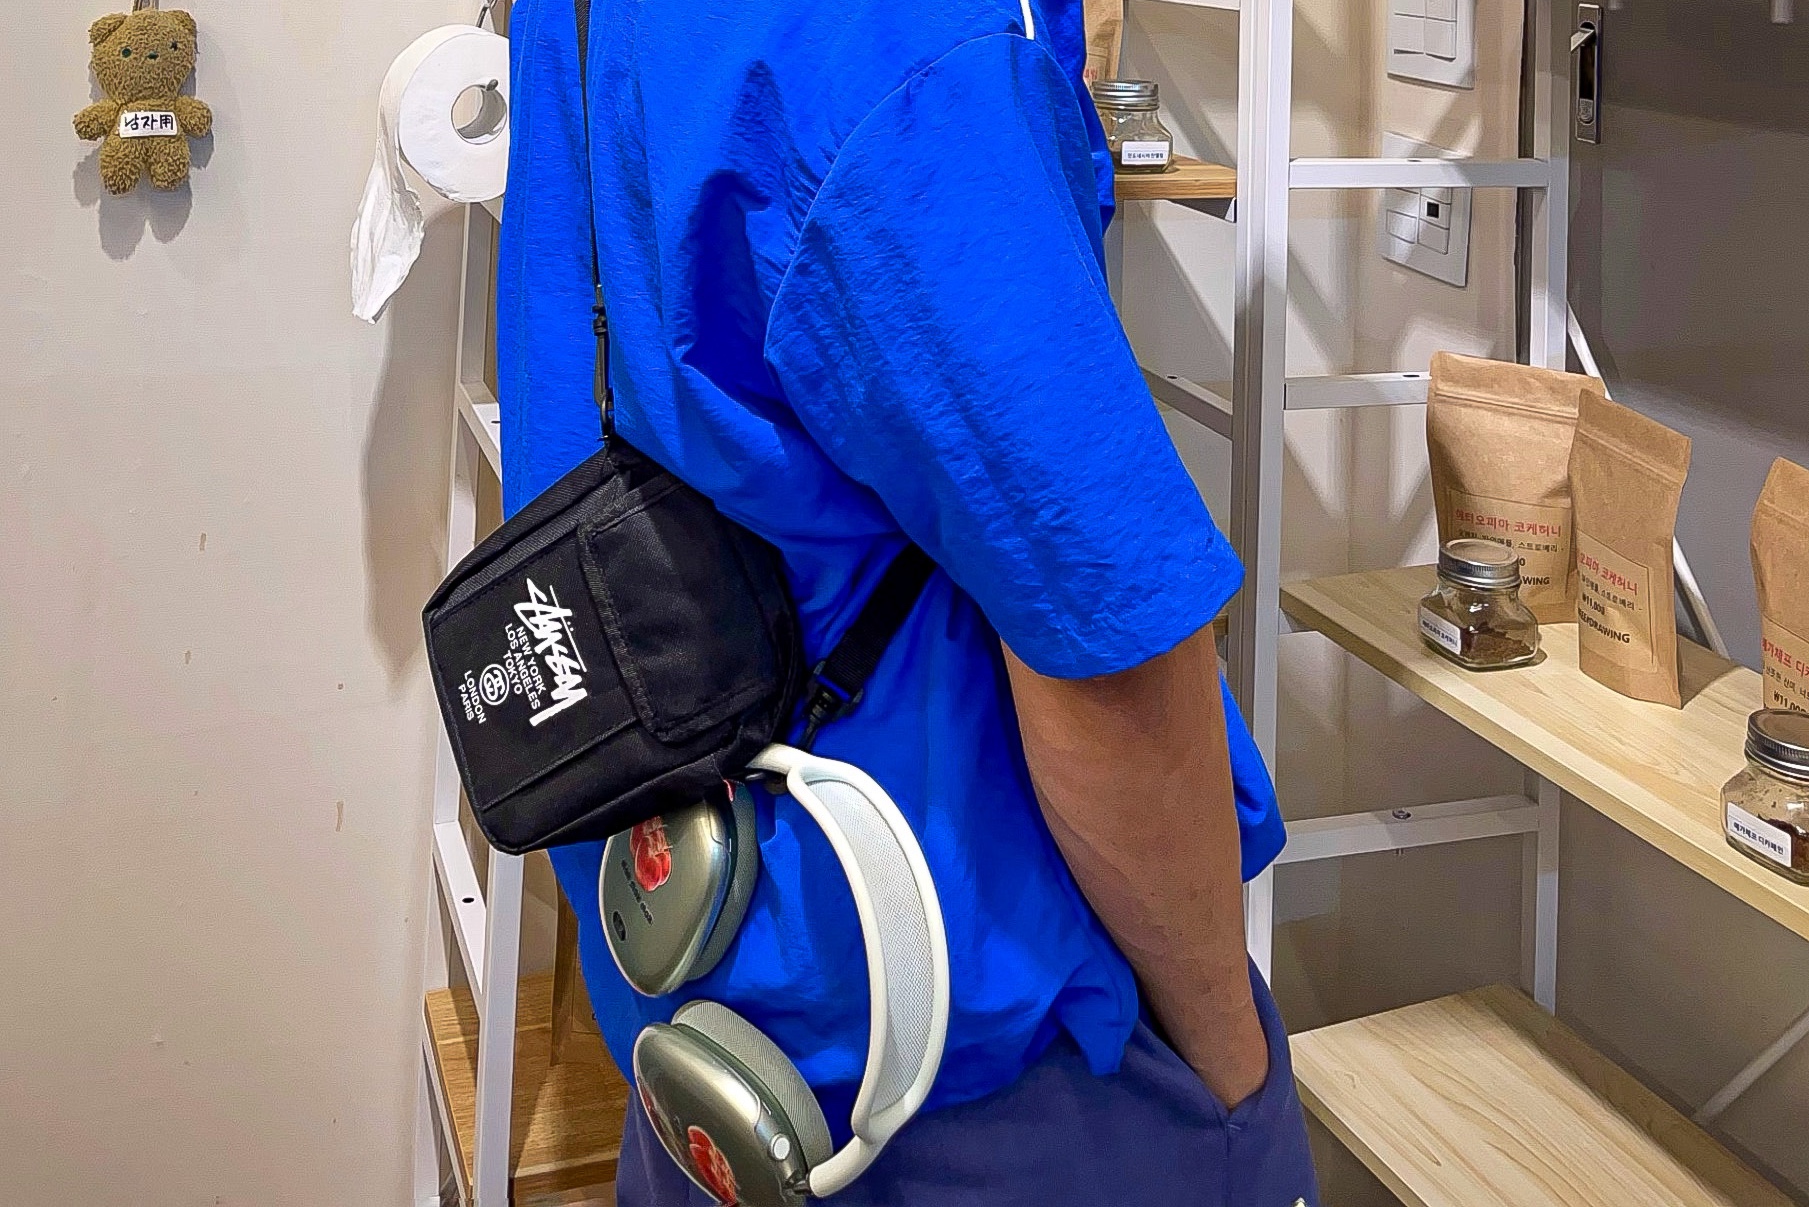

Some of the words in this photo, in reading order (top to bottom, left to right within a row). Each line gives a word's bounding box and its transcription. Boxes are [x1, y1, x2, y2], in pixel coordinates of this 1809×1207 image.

[1514, 521, 1561, 538] 코케허니
[502, 652, 523, 695] TOKYO
[504, 623, 518, 649] LOS
[513, 652, 541, 710] ANGELES
[516, 626, 532, 655] NEW
[526, 654, 547, 697] YORK
[458, 685, 475, 721] PARIS
[464, 670, 486, 724] LONDON
